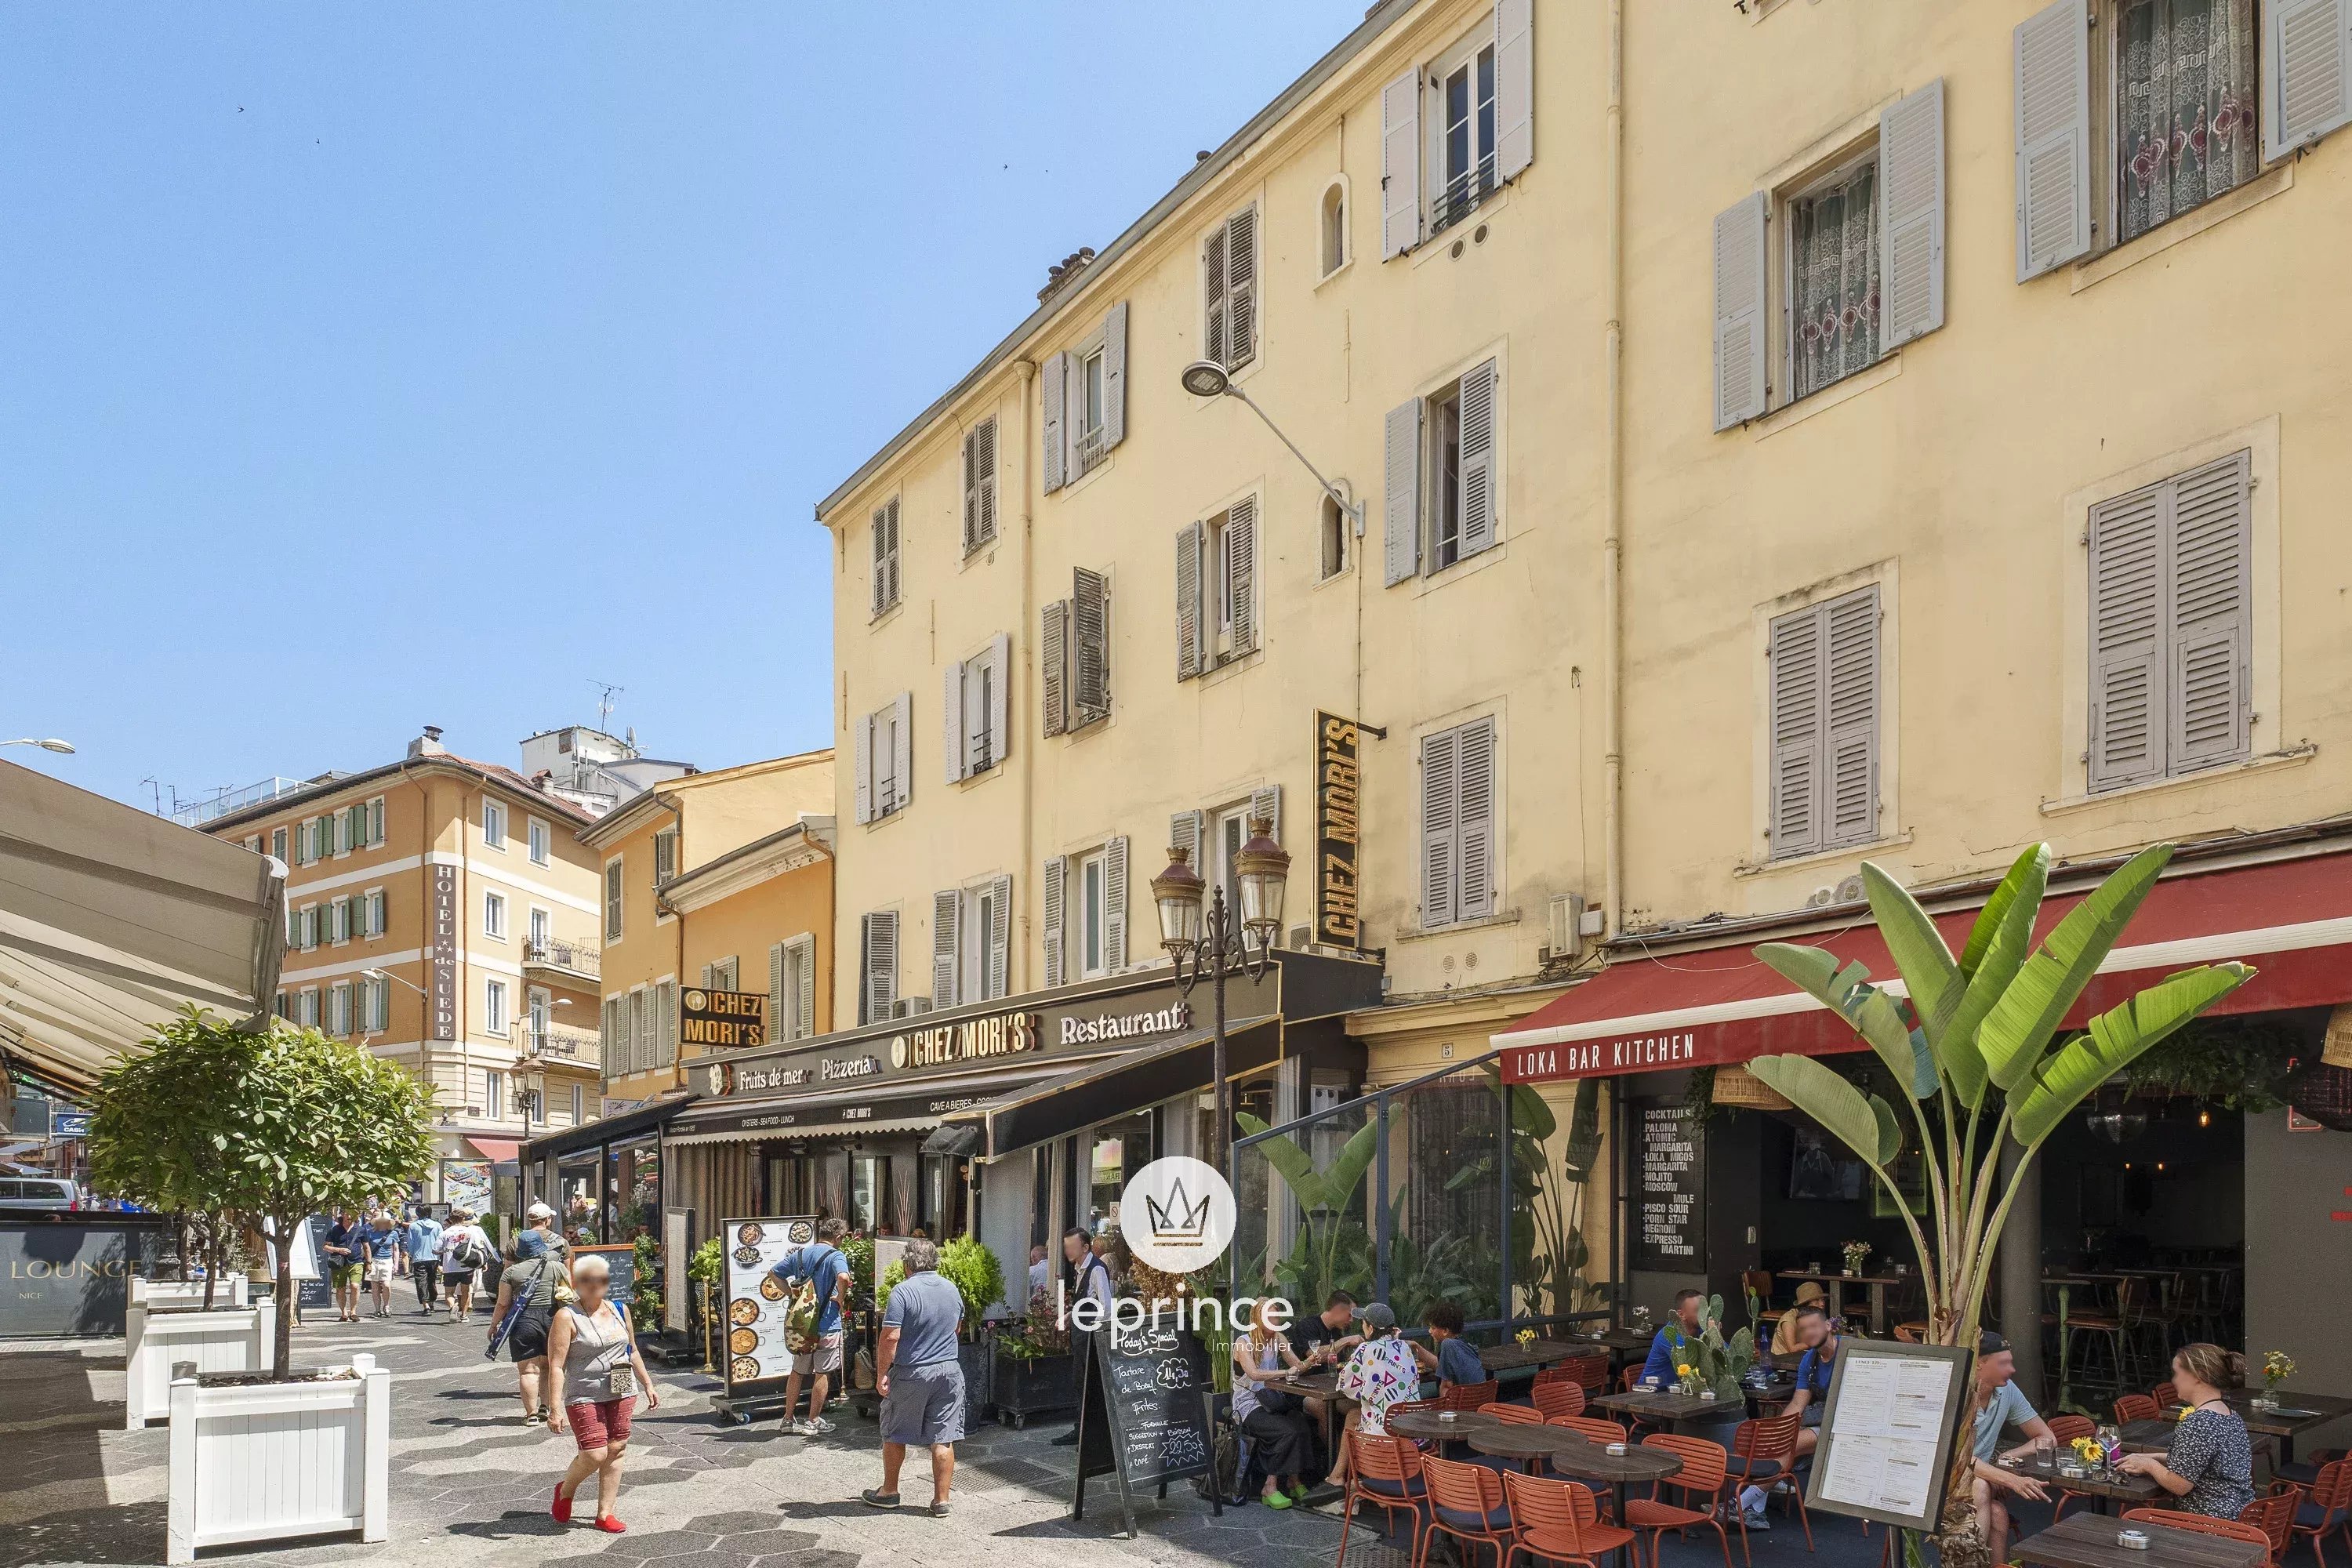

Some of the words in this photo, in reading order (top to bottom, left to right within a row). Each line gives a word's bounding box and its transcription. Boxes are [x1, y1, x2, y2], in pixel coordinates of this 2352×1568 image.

[1323, 718, 1358, 844] MORI'S
[437, 865, 453, 936] HOTEL
[1323, 853, 1358, 936] CHEZ
[434, 956, 456, 966] de
[437, 968, 453, 1038] SUEDE
[713, 992, 761, 1017] CHEZ
[1059, 1000, 1188, 1046] Restaurant
[684, 1018, 762, 1047] MORI'S
[914, 1025, 954, 1068] CHEZ
[962, 1012, 1029, 1058] MORI'S
[1444, 1045, 1450, 1056] 5
[1518, 1050, 1556, 1076] LOKA
[1569, 1044, 1600, 1071] BAR
[1613, 1033, 1693, 1065] KITCHEN
[821, 1055, 873, 1080] Pizzeria
[739, 1069, 767, 1091] Fruits
[768, 1067, 781, 1087] de
[782, 1069, 804, 1085] mer
[930, 1101, 946, 1112] CAVE
[950, 1098, 972, 1110] BIERES
[1645, 1109, 1692, 1120] COCKTAILS
[742, 1118, 758, 1127] OYSTERS
[780, 1115, 795, 1124] LUNCH
[1645, 1123, 1678, 1133] PALOMA
[1645, 1133, 1676, 1142] ATOMIC
[1650, 1142, 1693, 1152] MARGARITA
[1645, 1152, 1664, 1162] LOKA
[1670, 1152, 1694, 1162] MIGOS
[1645, 1162, 1688, 1171] MARGARITA
[1645, 1172, 1672, 1181] MOJITO
[1645, 1182, 1678, 1192] MOSCOW
[1673, 1194, 1694, 1204] MULE
[1645, 1203, 1666, 1214] PISCO
[1668, 1204, 1689, 1214] SOUR
[1645, 1214, 1665, 1224] PORN
[1668, 1214, 1687, 1225] STAR
[1645, 1225, 1676, 1234] NEGRONI
[1645, 1233, 1682, 1245] EXPRESSO
[1661, 1245, 1693, 1255] MARTINI
[10, 1260, 142, 1279] LOUNGE
[1148, 1328, 1178, 1348] Special
[1113, 1365, 1145, 1378] Tartare
[1121, 1384, 1132, 1394] de
[1168, 1439, 1198, 1454] 22,50
